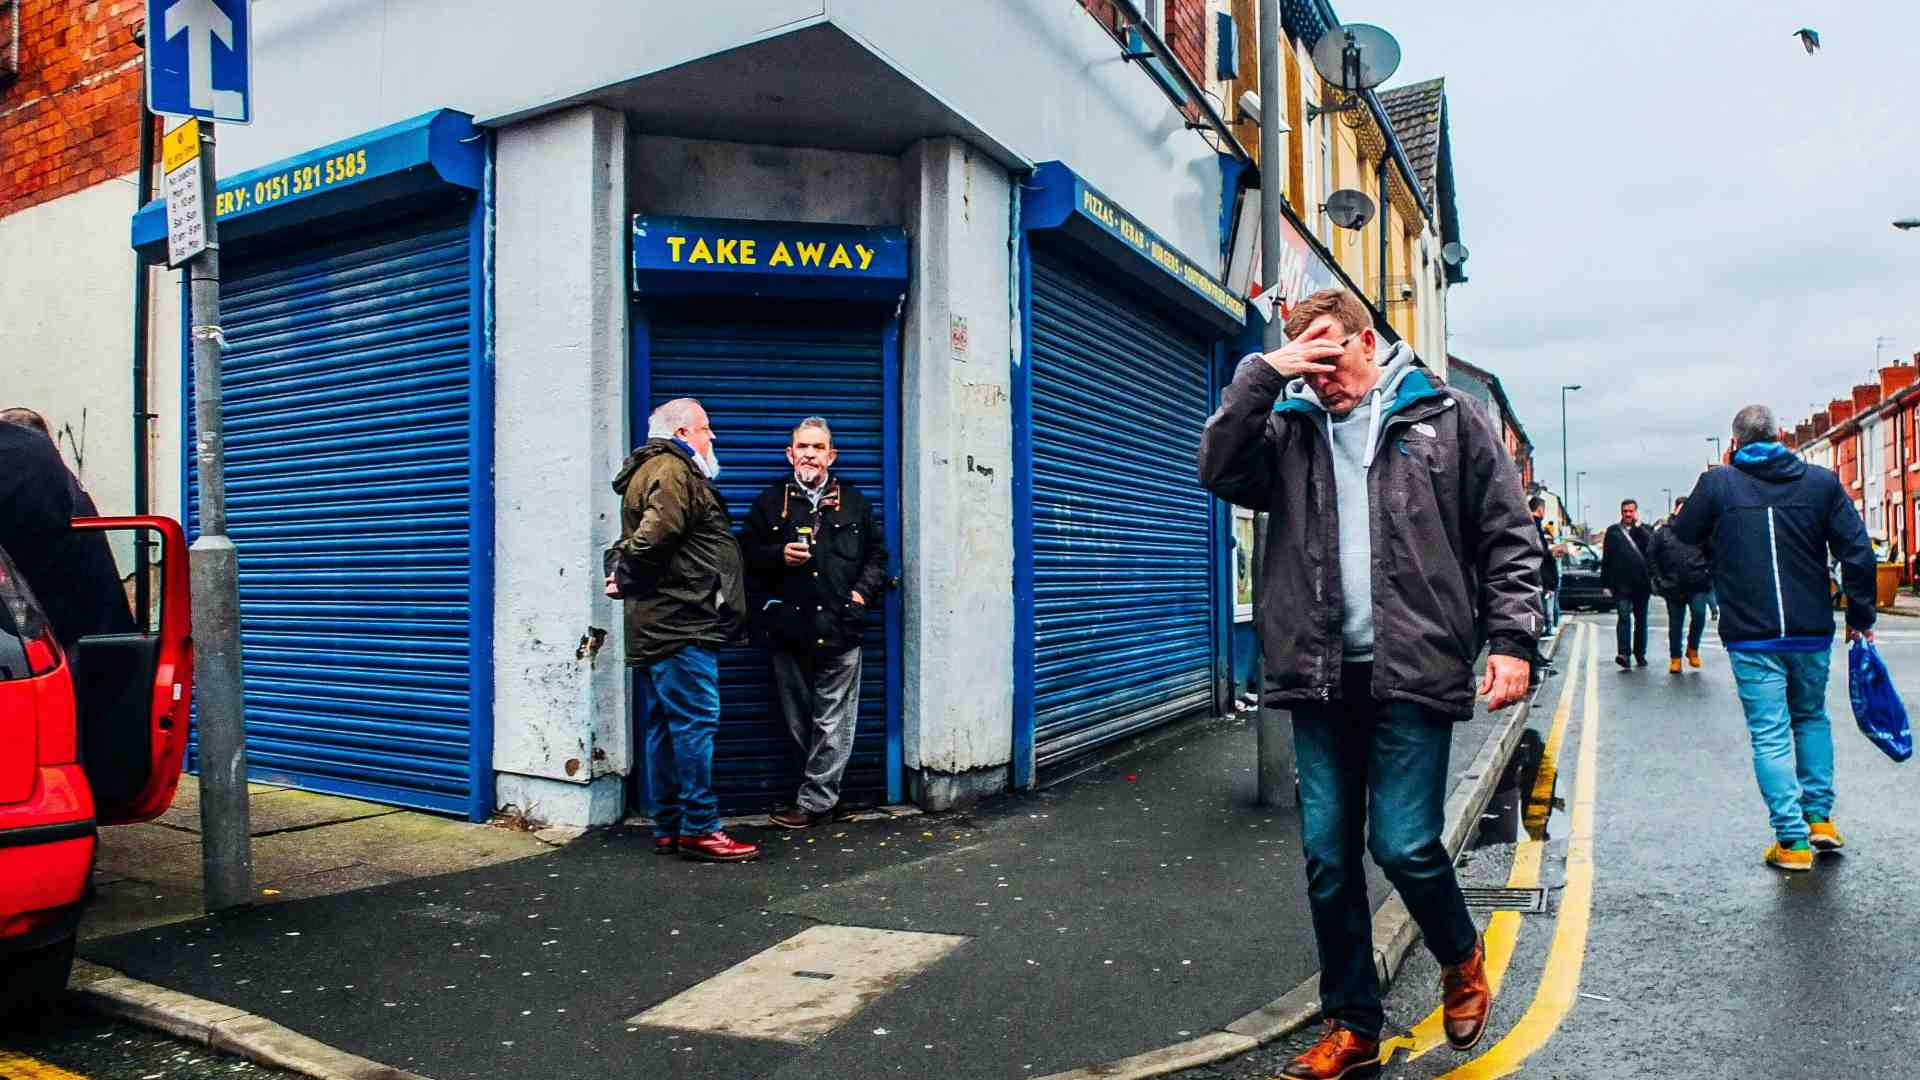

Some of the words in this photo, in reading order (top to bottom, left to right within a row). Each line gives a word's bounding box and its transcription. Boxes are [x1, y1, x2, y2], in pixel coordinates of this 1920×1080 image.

[215, 187, 250, 216] ERY:
[255, 174, 289, 204] 0151
[293, 165, 321, 194] 521
[325, 150, 367, 184] 5585
[1084, 190, 1114, 228] PIZZAS
[666, 237, 757, 265] TAKE
[769, 241, 875, 270] AWAY
